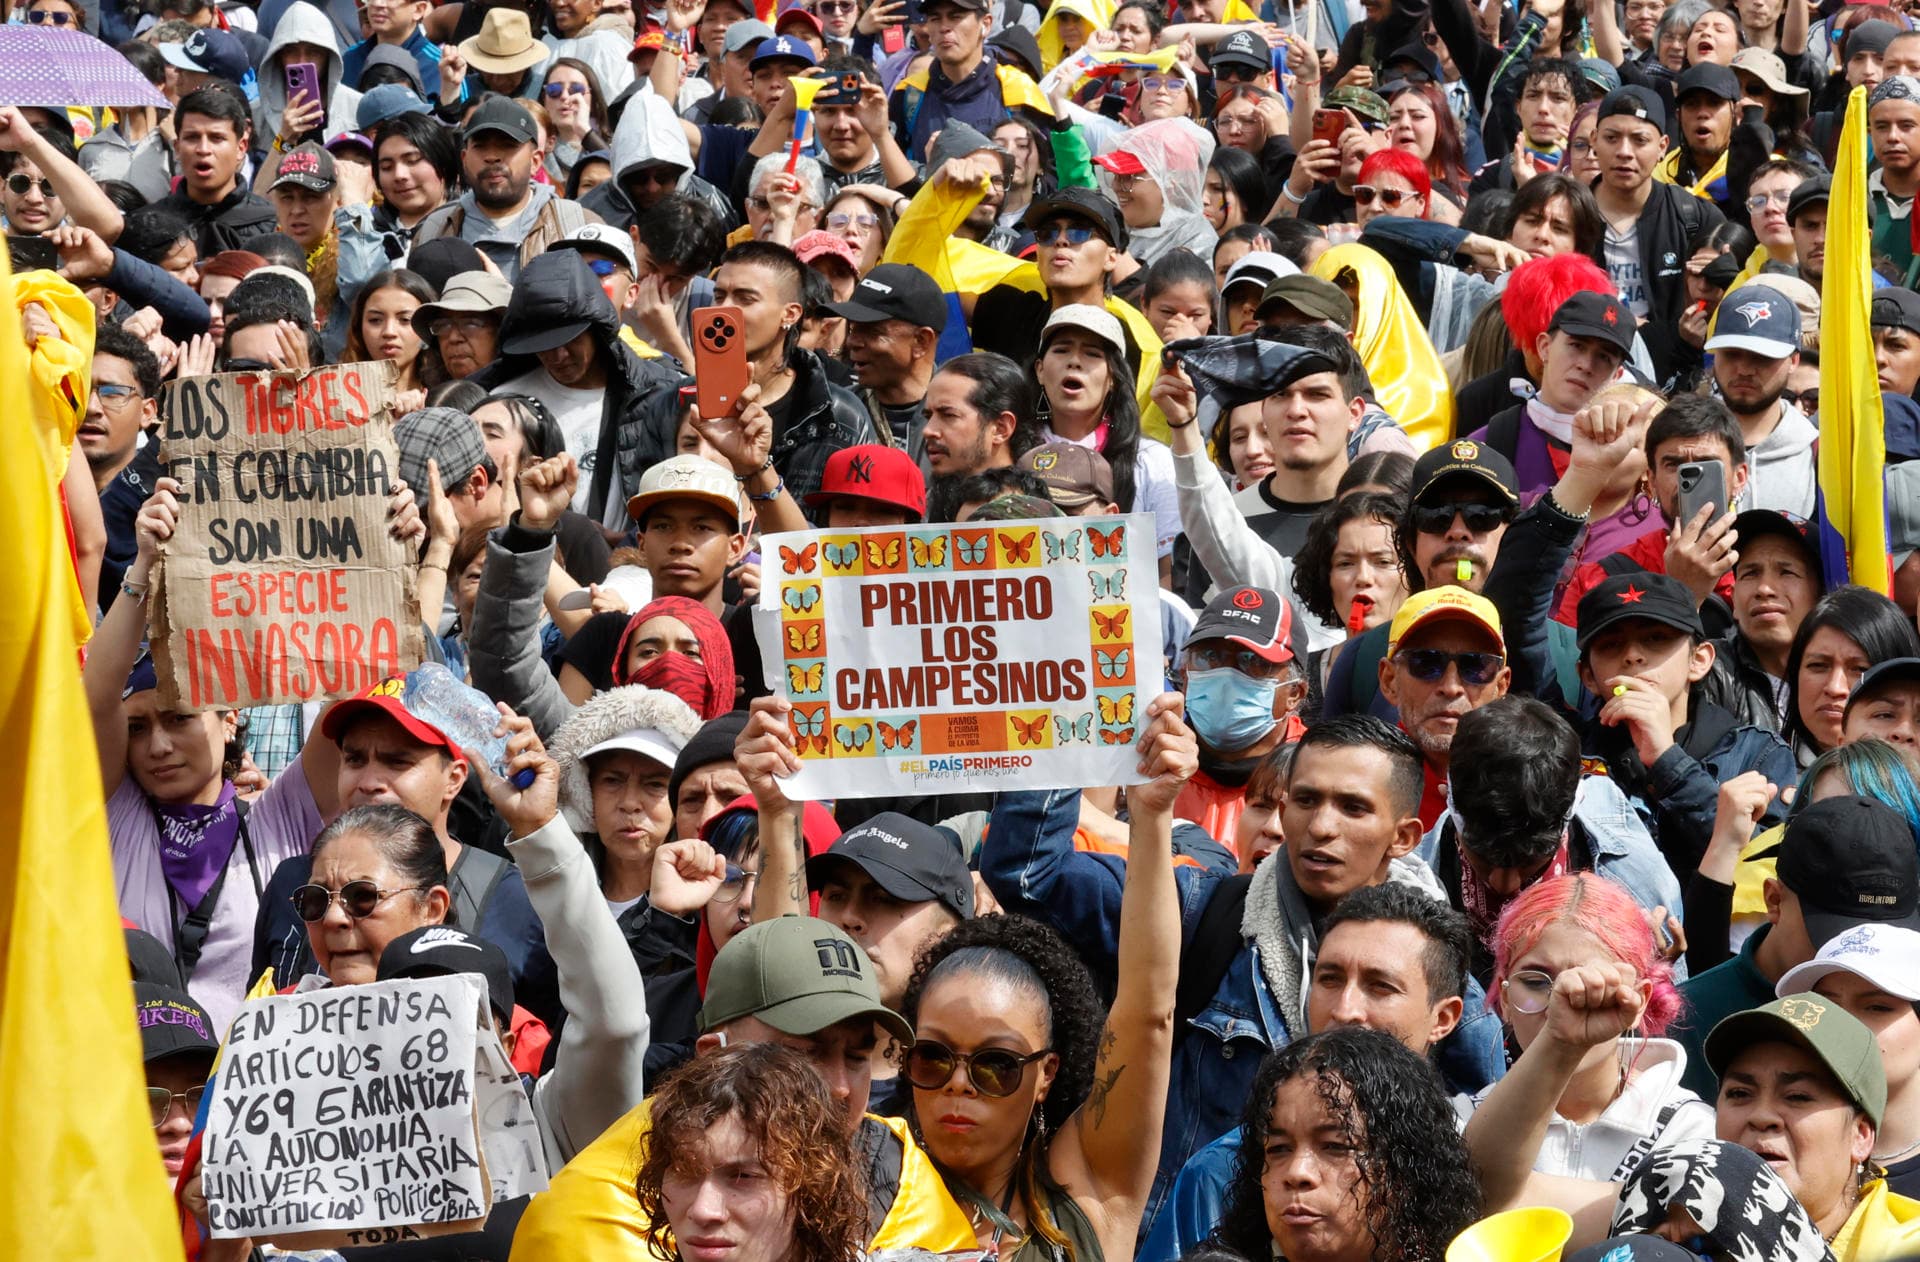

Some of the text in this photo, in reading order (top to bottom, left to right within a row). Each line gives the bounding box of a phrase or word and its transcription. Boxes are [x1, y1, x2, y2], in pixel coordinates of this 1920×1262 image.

[166, 372, 369, 441] LOS TIGRES
[169, 450, 221, 505] EN
[233, 447, 391, 504] COLOMBIA
[846, 454, 875, 483] NY
[208, 516, 363, 565] SON UNA
[210, 569, 349, 618] ESPECIE
[860, 575, 1053, 627] PRIMERO
[1222, 609, 1262, 625] DFAC
[186, 617, 399, 708] INVASORA
[921, 625, 998, 663] LOS
[836, 659, 1087, 711] CAMPESINOS
[948, 716, 978, 726] VAMOS
[913, 768, 950, 788] primero
[963, 767, 981, 785] que
[983, 767, 1000, 778] nos
[1002, 766, 1019, 776] une
[867, 827, 910, 850] Angels
[421, 927, 469, 942] NIKE
[138, 1006, 208, 1040] AKERS
[145, 1000, 163, 1009] LOS
[228, 991, 452, 1046] EN DEFENSA
[224, 1028, 449, 1091] ARTÍCULOS 68
[347, 1225, 420, 1245] TODA
